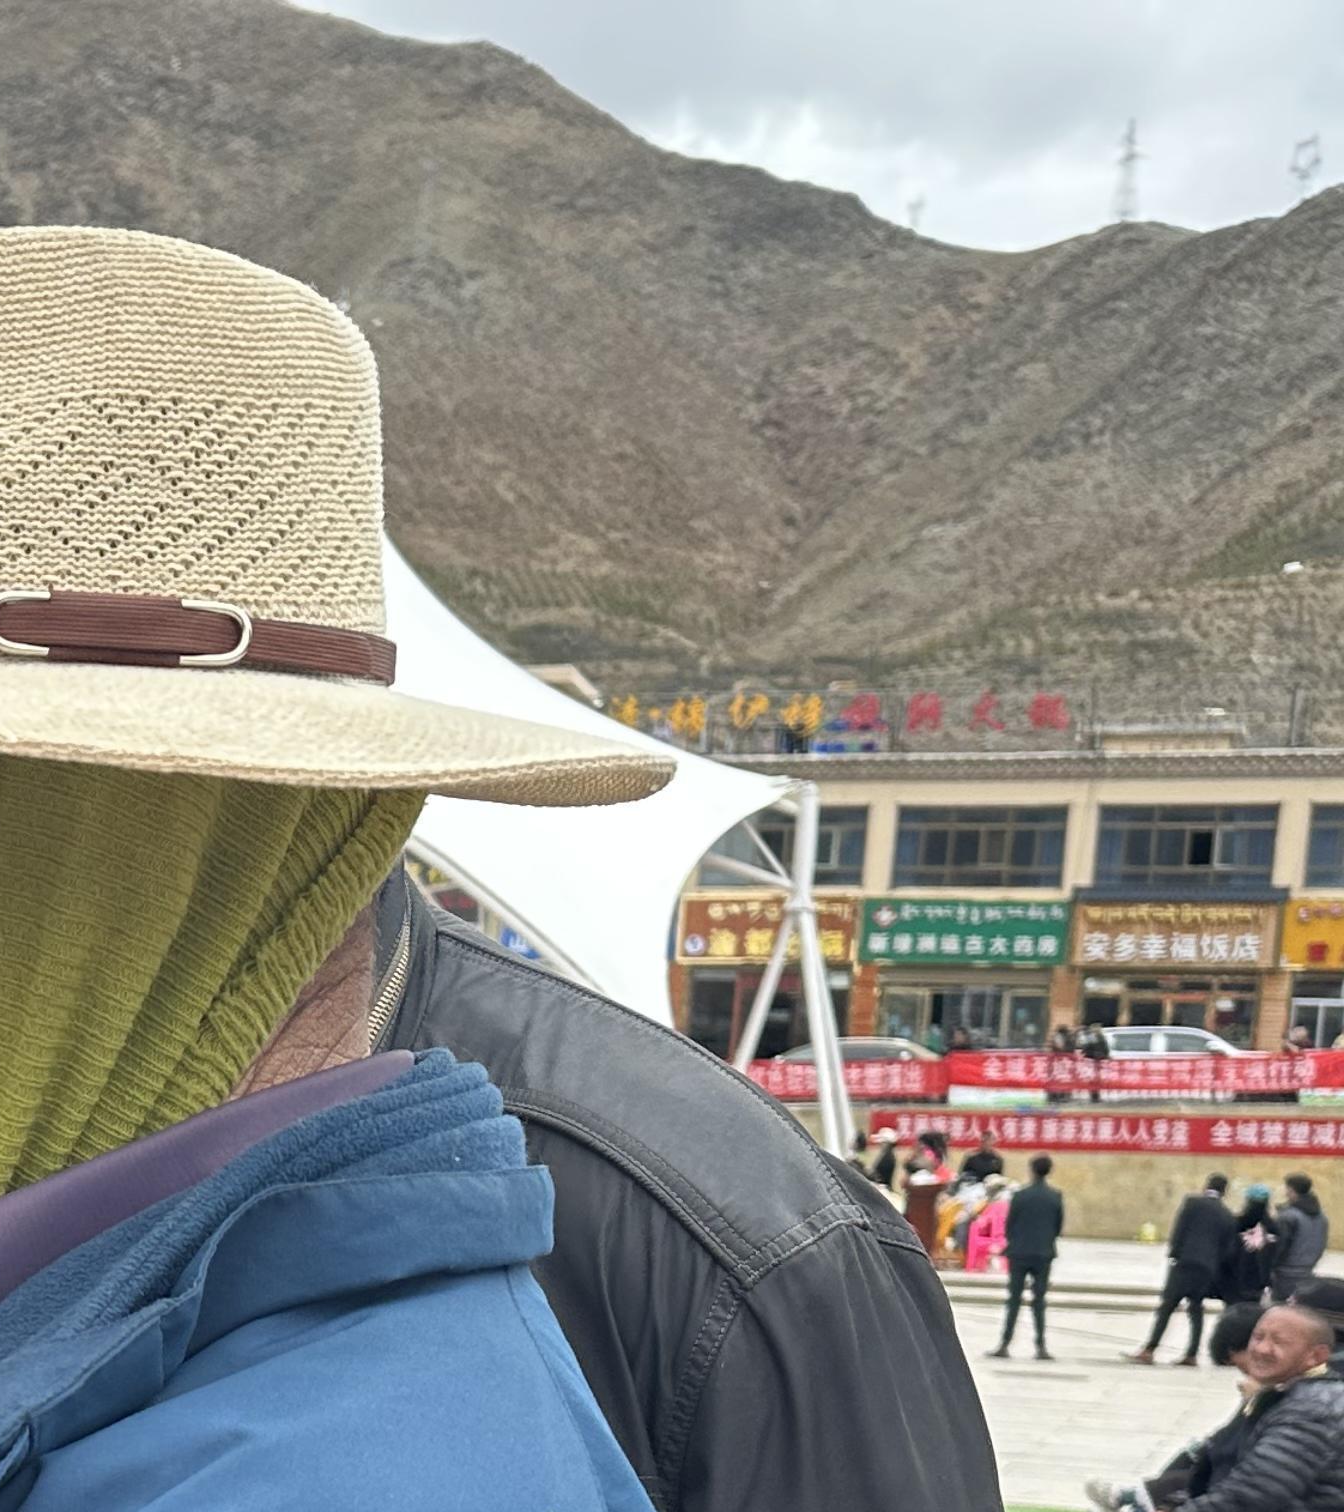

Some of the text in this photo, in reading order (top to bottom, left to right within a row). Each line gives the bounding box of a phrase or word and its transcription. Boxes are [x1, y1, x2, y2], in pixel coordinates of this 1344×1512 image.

[1083, 931, 1261, 962] 安多幸福饭店
